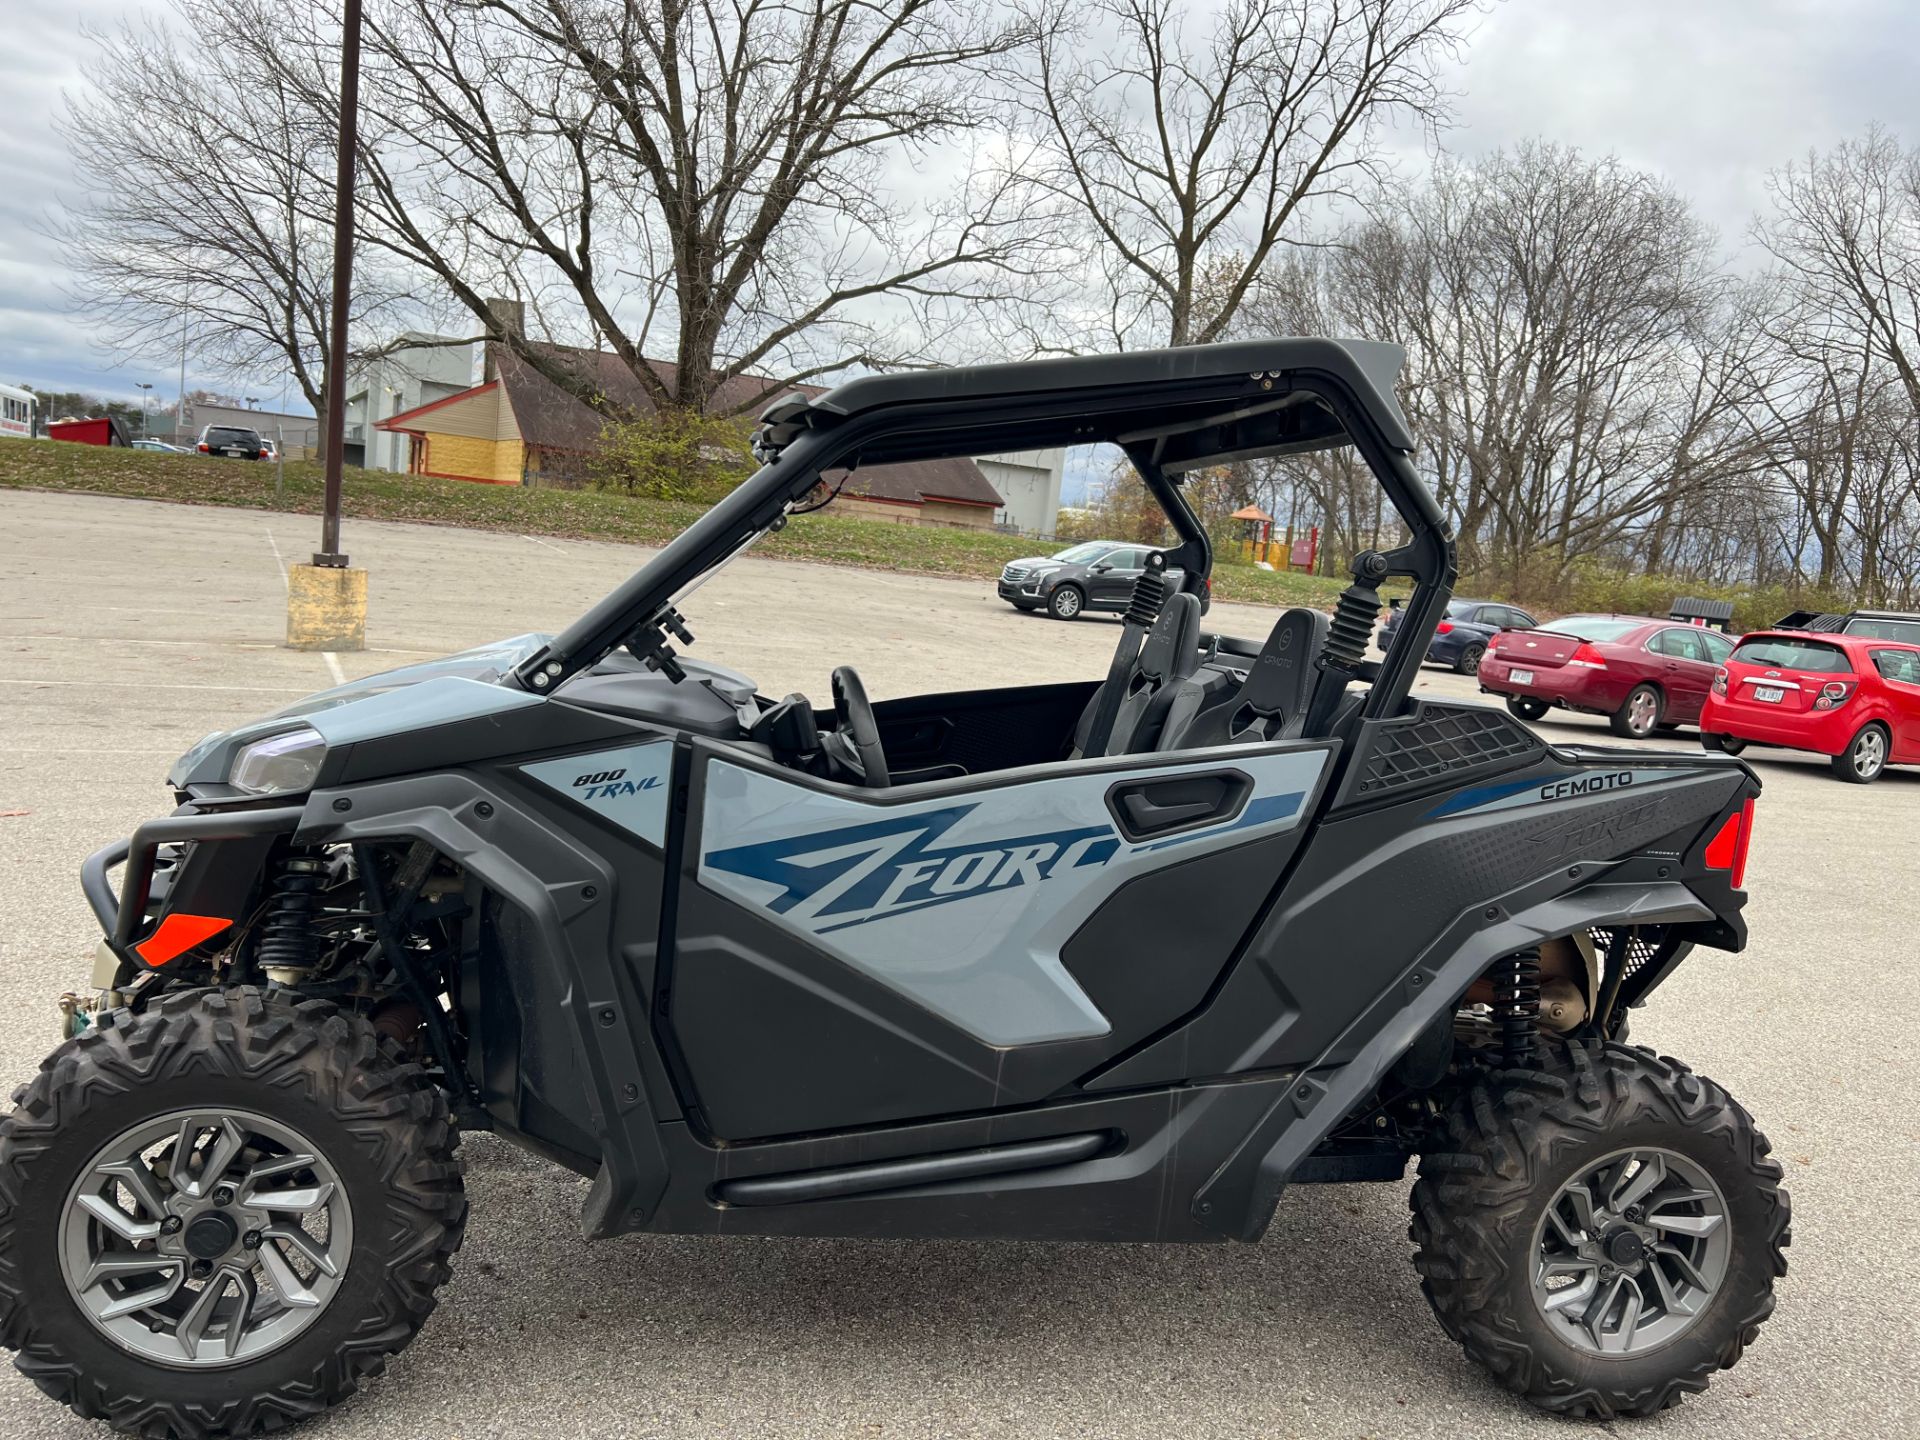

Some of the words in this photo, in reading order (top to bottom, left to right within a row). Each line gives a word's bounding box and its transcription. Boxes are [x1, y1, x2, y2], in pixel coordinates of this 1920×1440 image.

[572, 768, 627, 787] 800
[583, 776, 665, 801] TRAIL
[1541, 771, 1633, 800] CFMOTO
